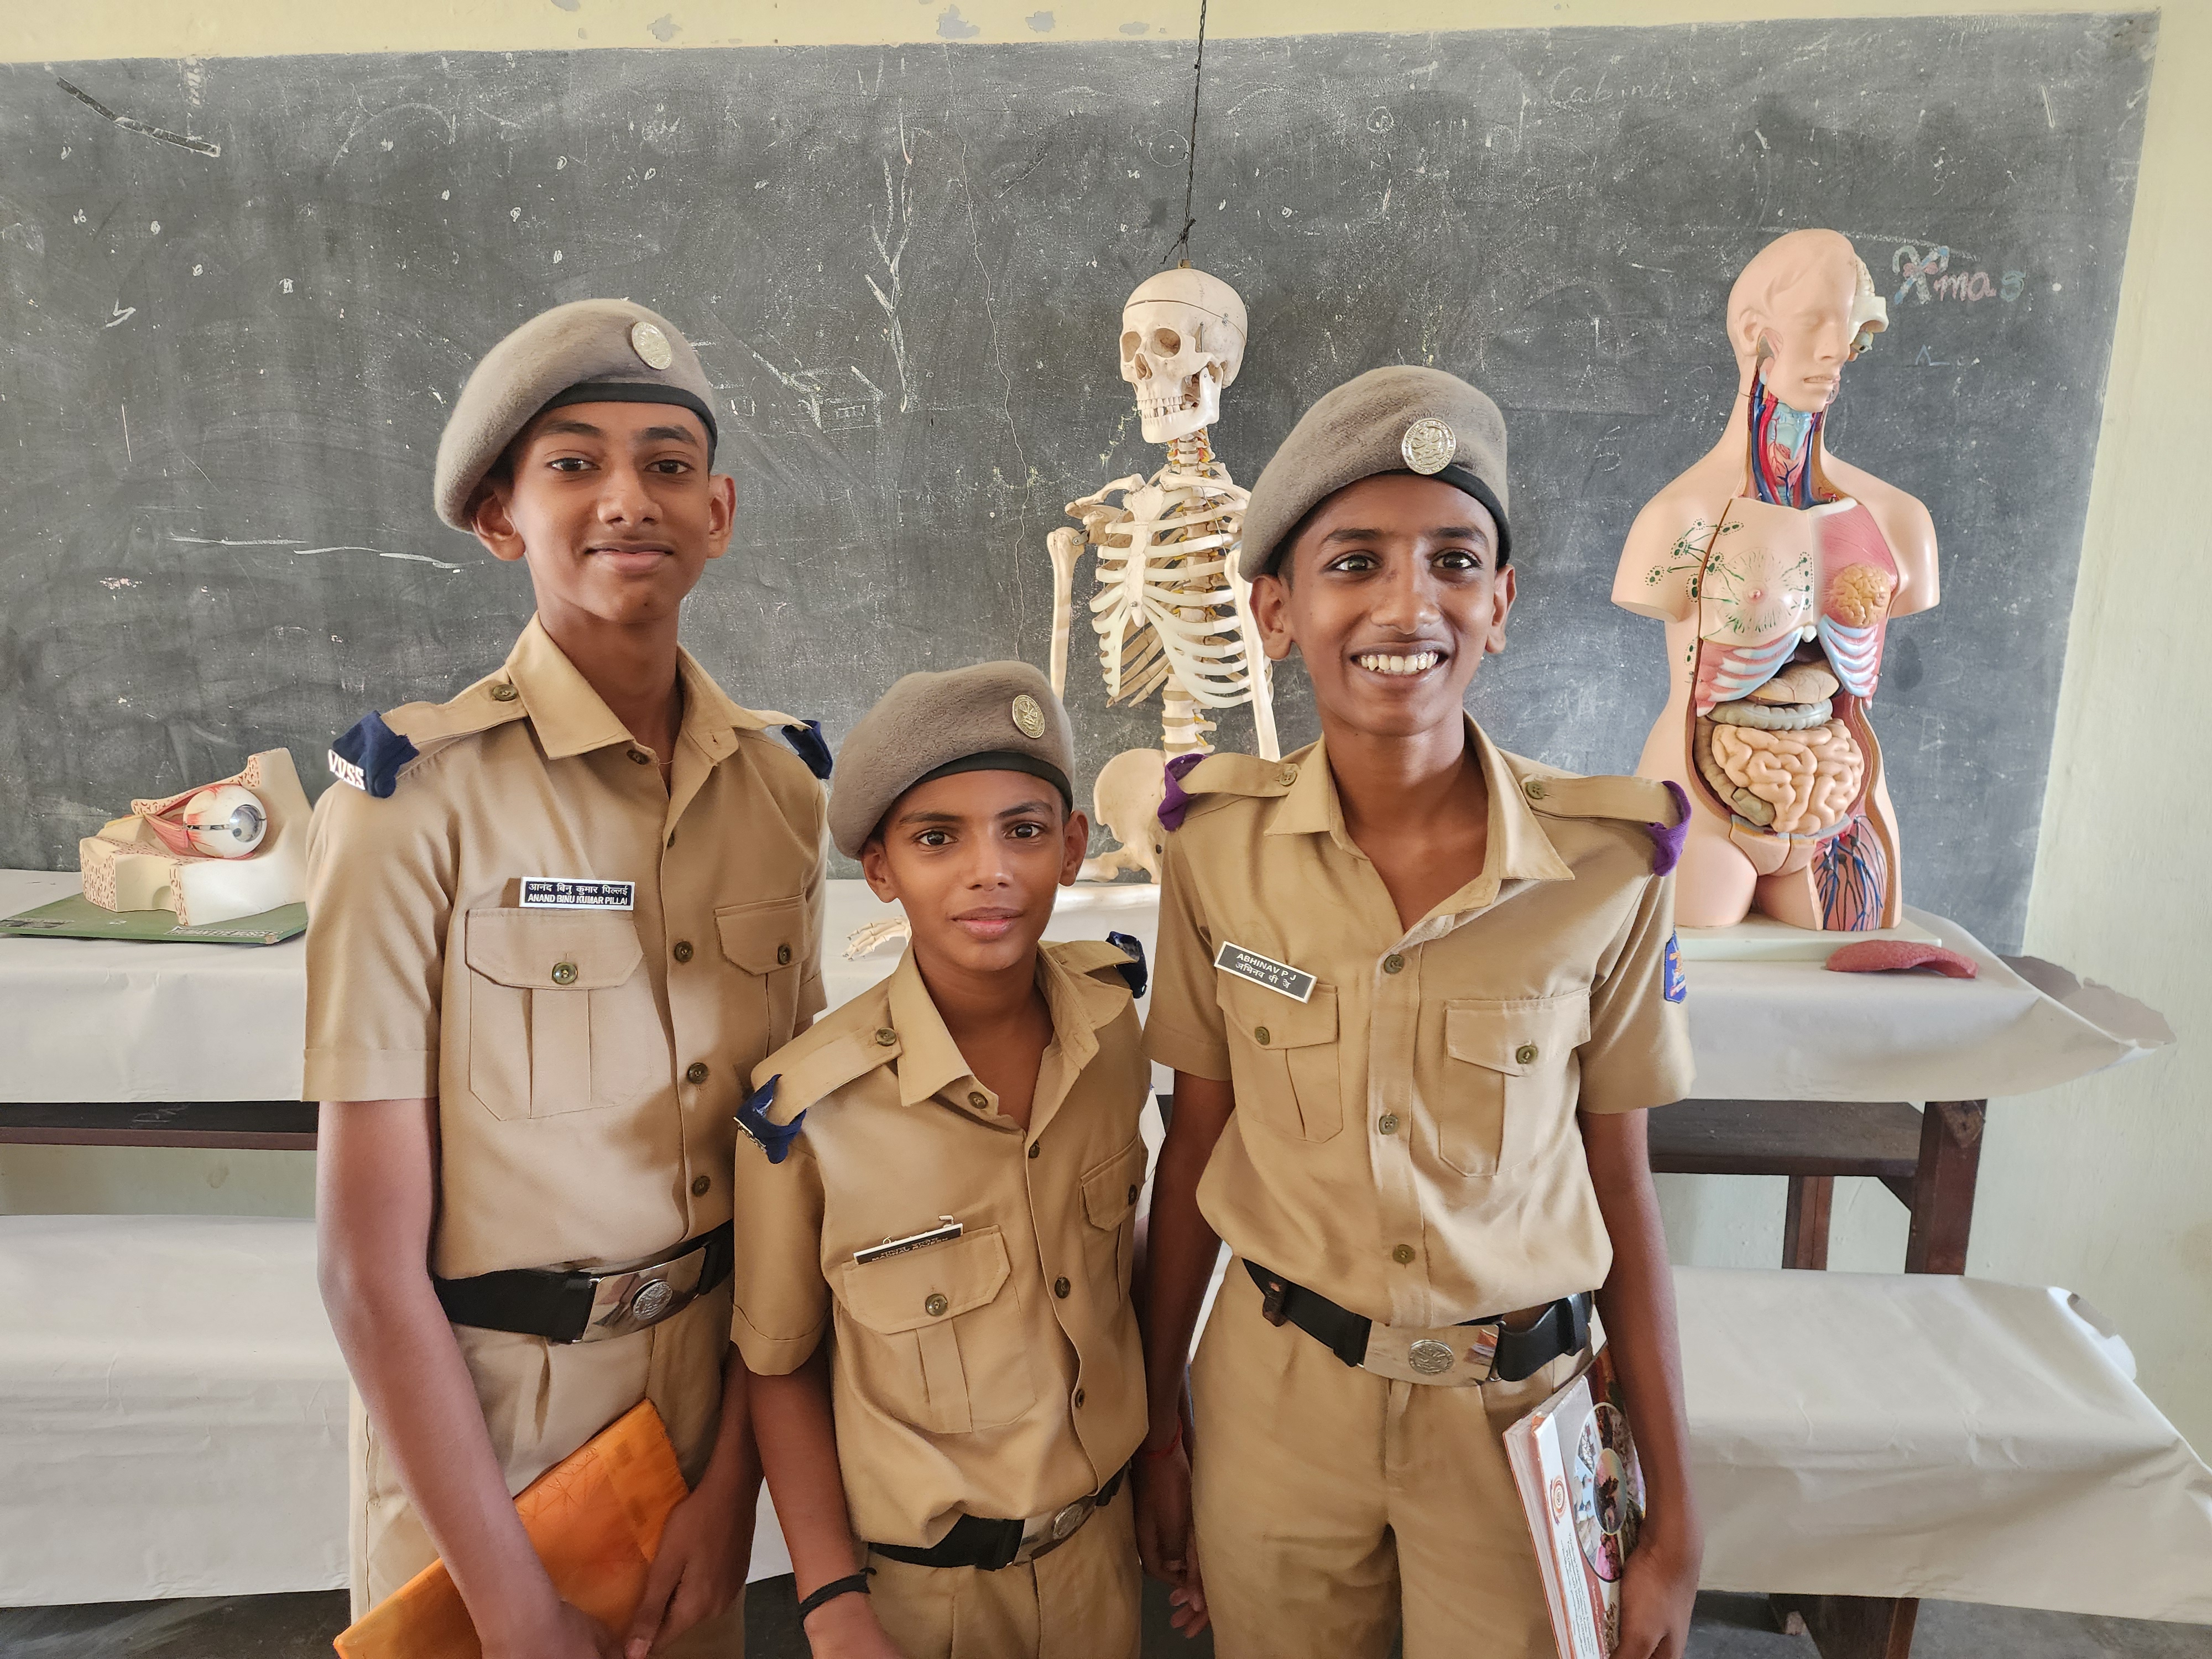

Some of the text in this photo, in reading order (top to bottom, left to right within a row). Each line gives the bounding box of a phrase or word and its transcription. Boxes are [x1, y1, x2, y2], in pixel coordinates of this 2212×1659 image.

[528, 883, 628, 895] आनंद बिनु कुमार पिल्लई
[576, 895, 603, 904] KUMAR
[604, 897, 628, 905] PILLAI
[1236, 953, 1280, 974] ABHINAV
